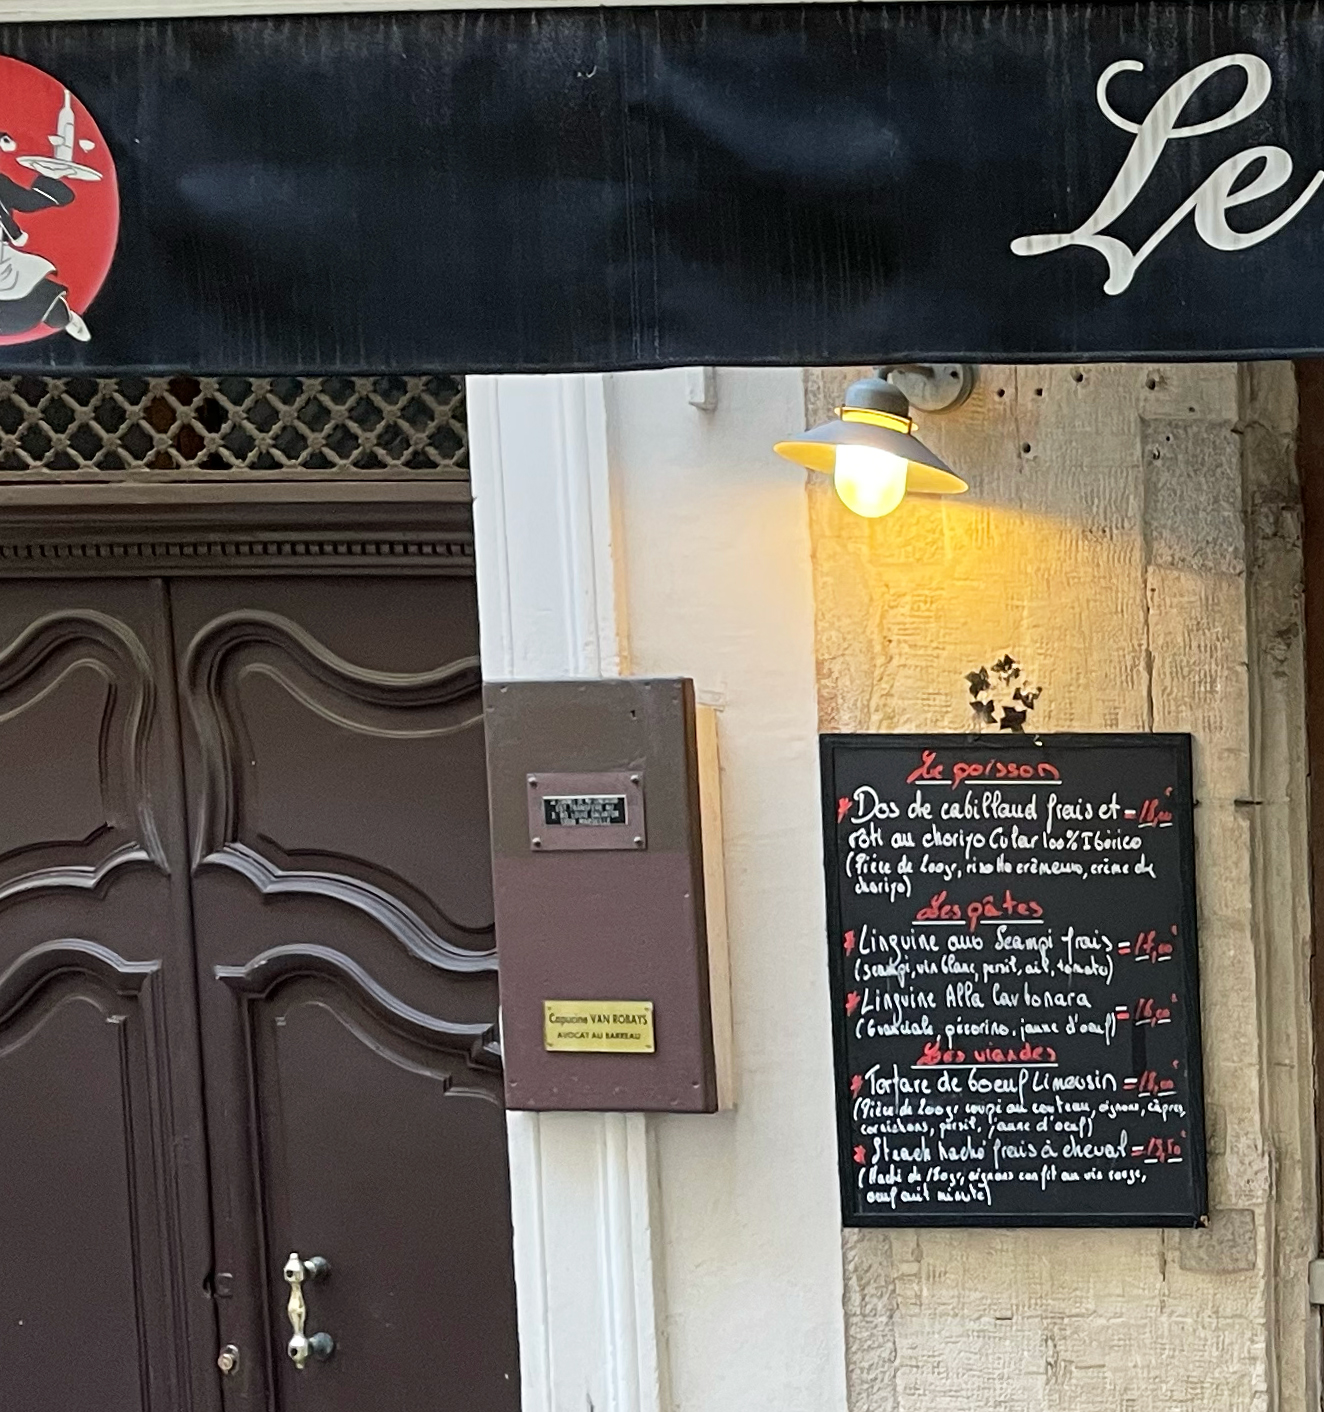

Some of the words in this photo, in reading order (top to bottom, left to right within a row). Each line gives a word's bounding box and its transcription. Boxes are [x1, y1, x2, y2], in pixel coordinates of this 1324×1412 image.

[953, 758, 1060, 790] poisson
[851, 786, 900, 823] Dos
[907, 790, 932, 819] de
[941, 790, 1037, 820] cabillaud
[1047, 793, 1093, 834] frais
[1098, 792, 1121, 820] et
[891, 832, 915, 848] au
[897, 854, 913, 873] de
[967, 889, 1043, 932] pâtes
[859, 924, 939, 964] Linguine
[1061, 926, 1113, 965] frais
[590, 1014, 610, 1024] VAN
[861, 986, 936, 1026] Linguine
[946, 981, 984, 1008] Alla
[993, 982, 1092, 1008] Carbonara
[938, 1070, 962, 1092] de
[993, 1138, 1036, 1169] frais
[1040, 1139, 1058, 1157] à
[1062, 1130, 1128, 1157] cheval
